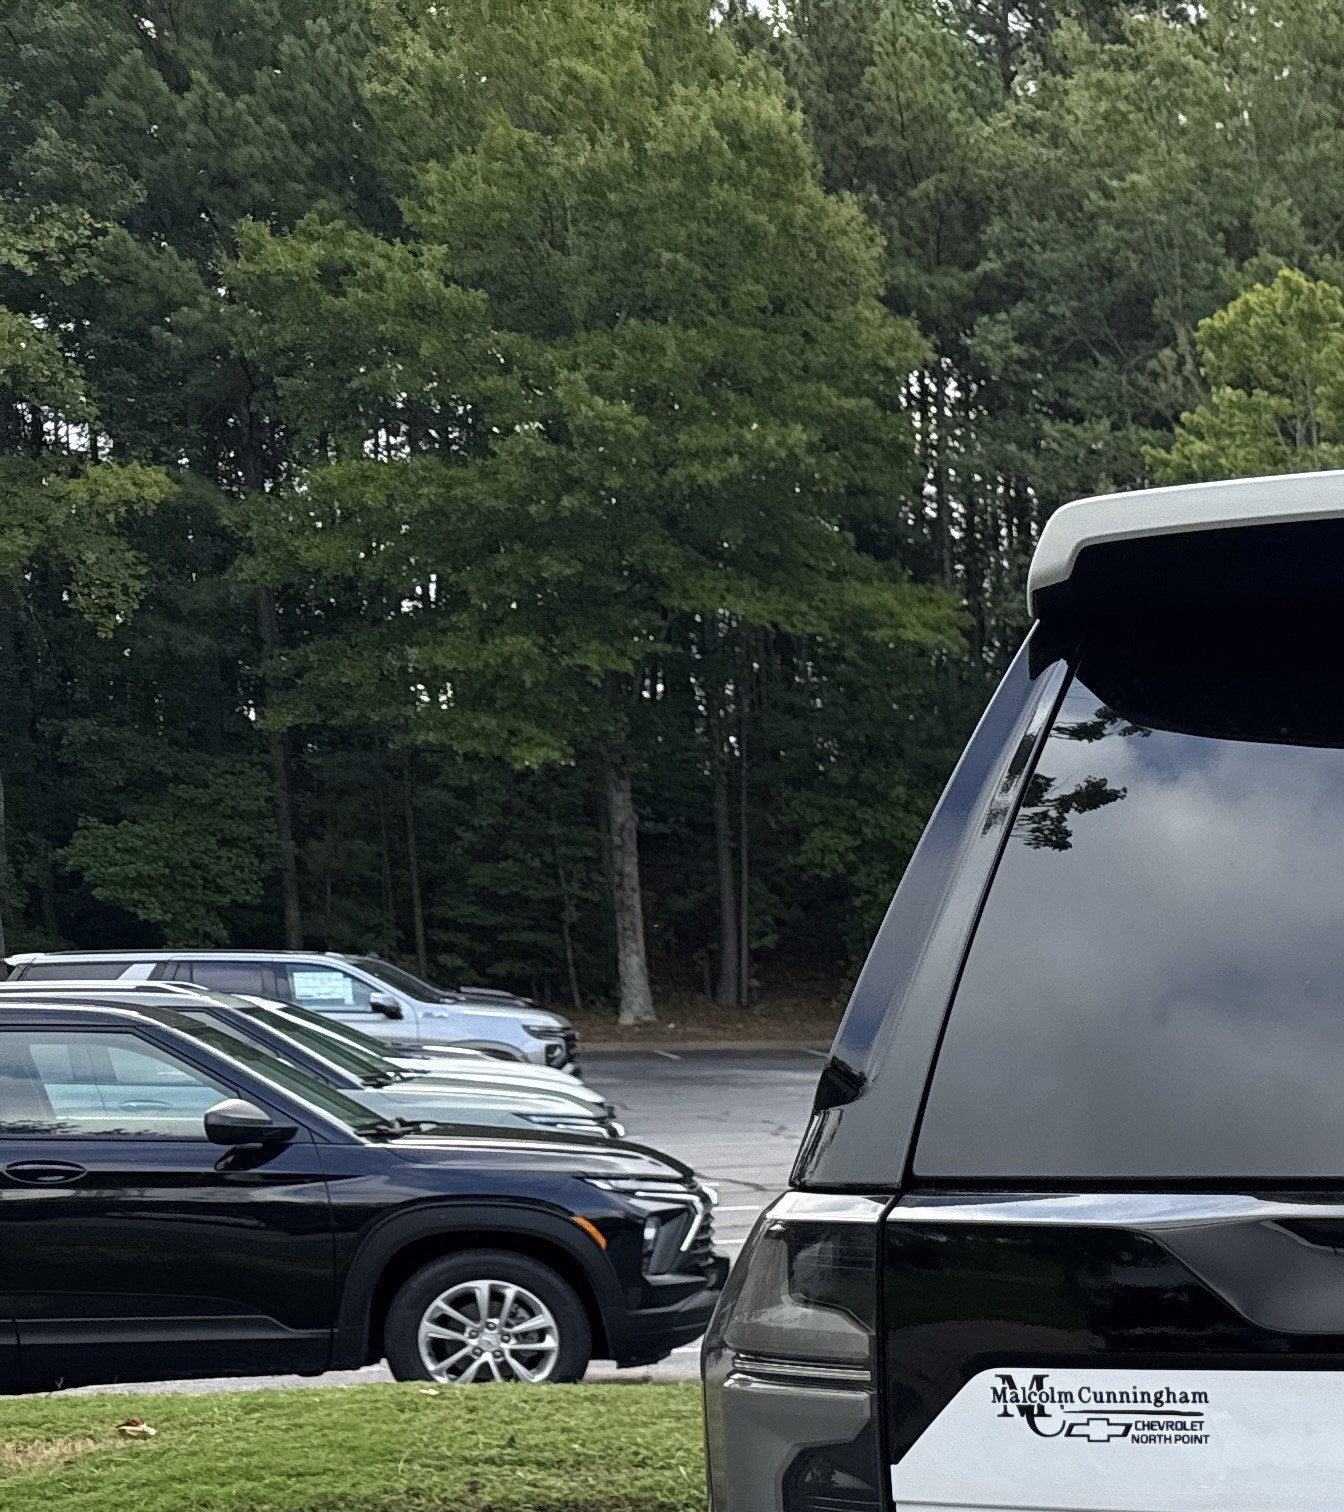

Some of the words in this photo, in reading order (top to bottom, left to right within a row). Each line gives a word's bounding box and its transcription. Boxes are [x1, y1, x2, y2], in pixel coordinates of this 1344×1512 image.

[990, 1386, 1075, 1404] Malcolm
[1078, 1386, 1210, 1407] Cunningham
[1134, 1420, 1205, 1432] CHEVROLET
[1131, 1434, 1172, 1445] NORTH
[1174, 1434, 1211, 1445] POINT
